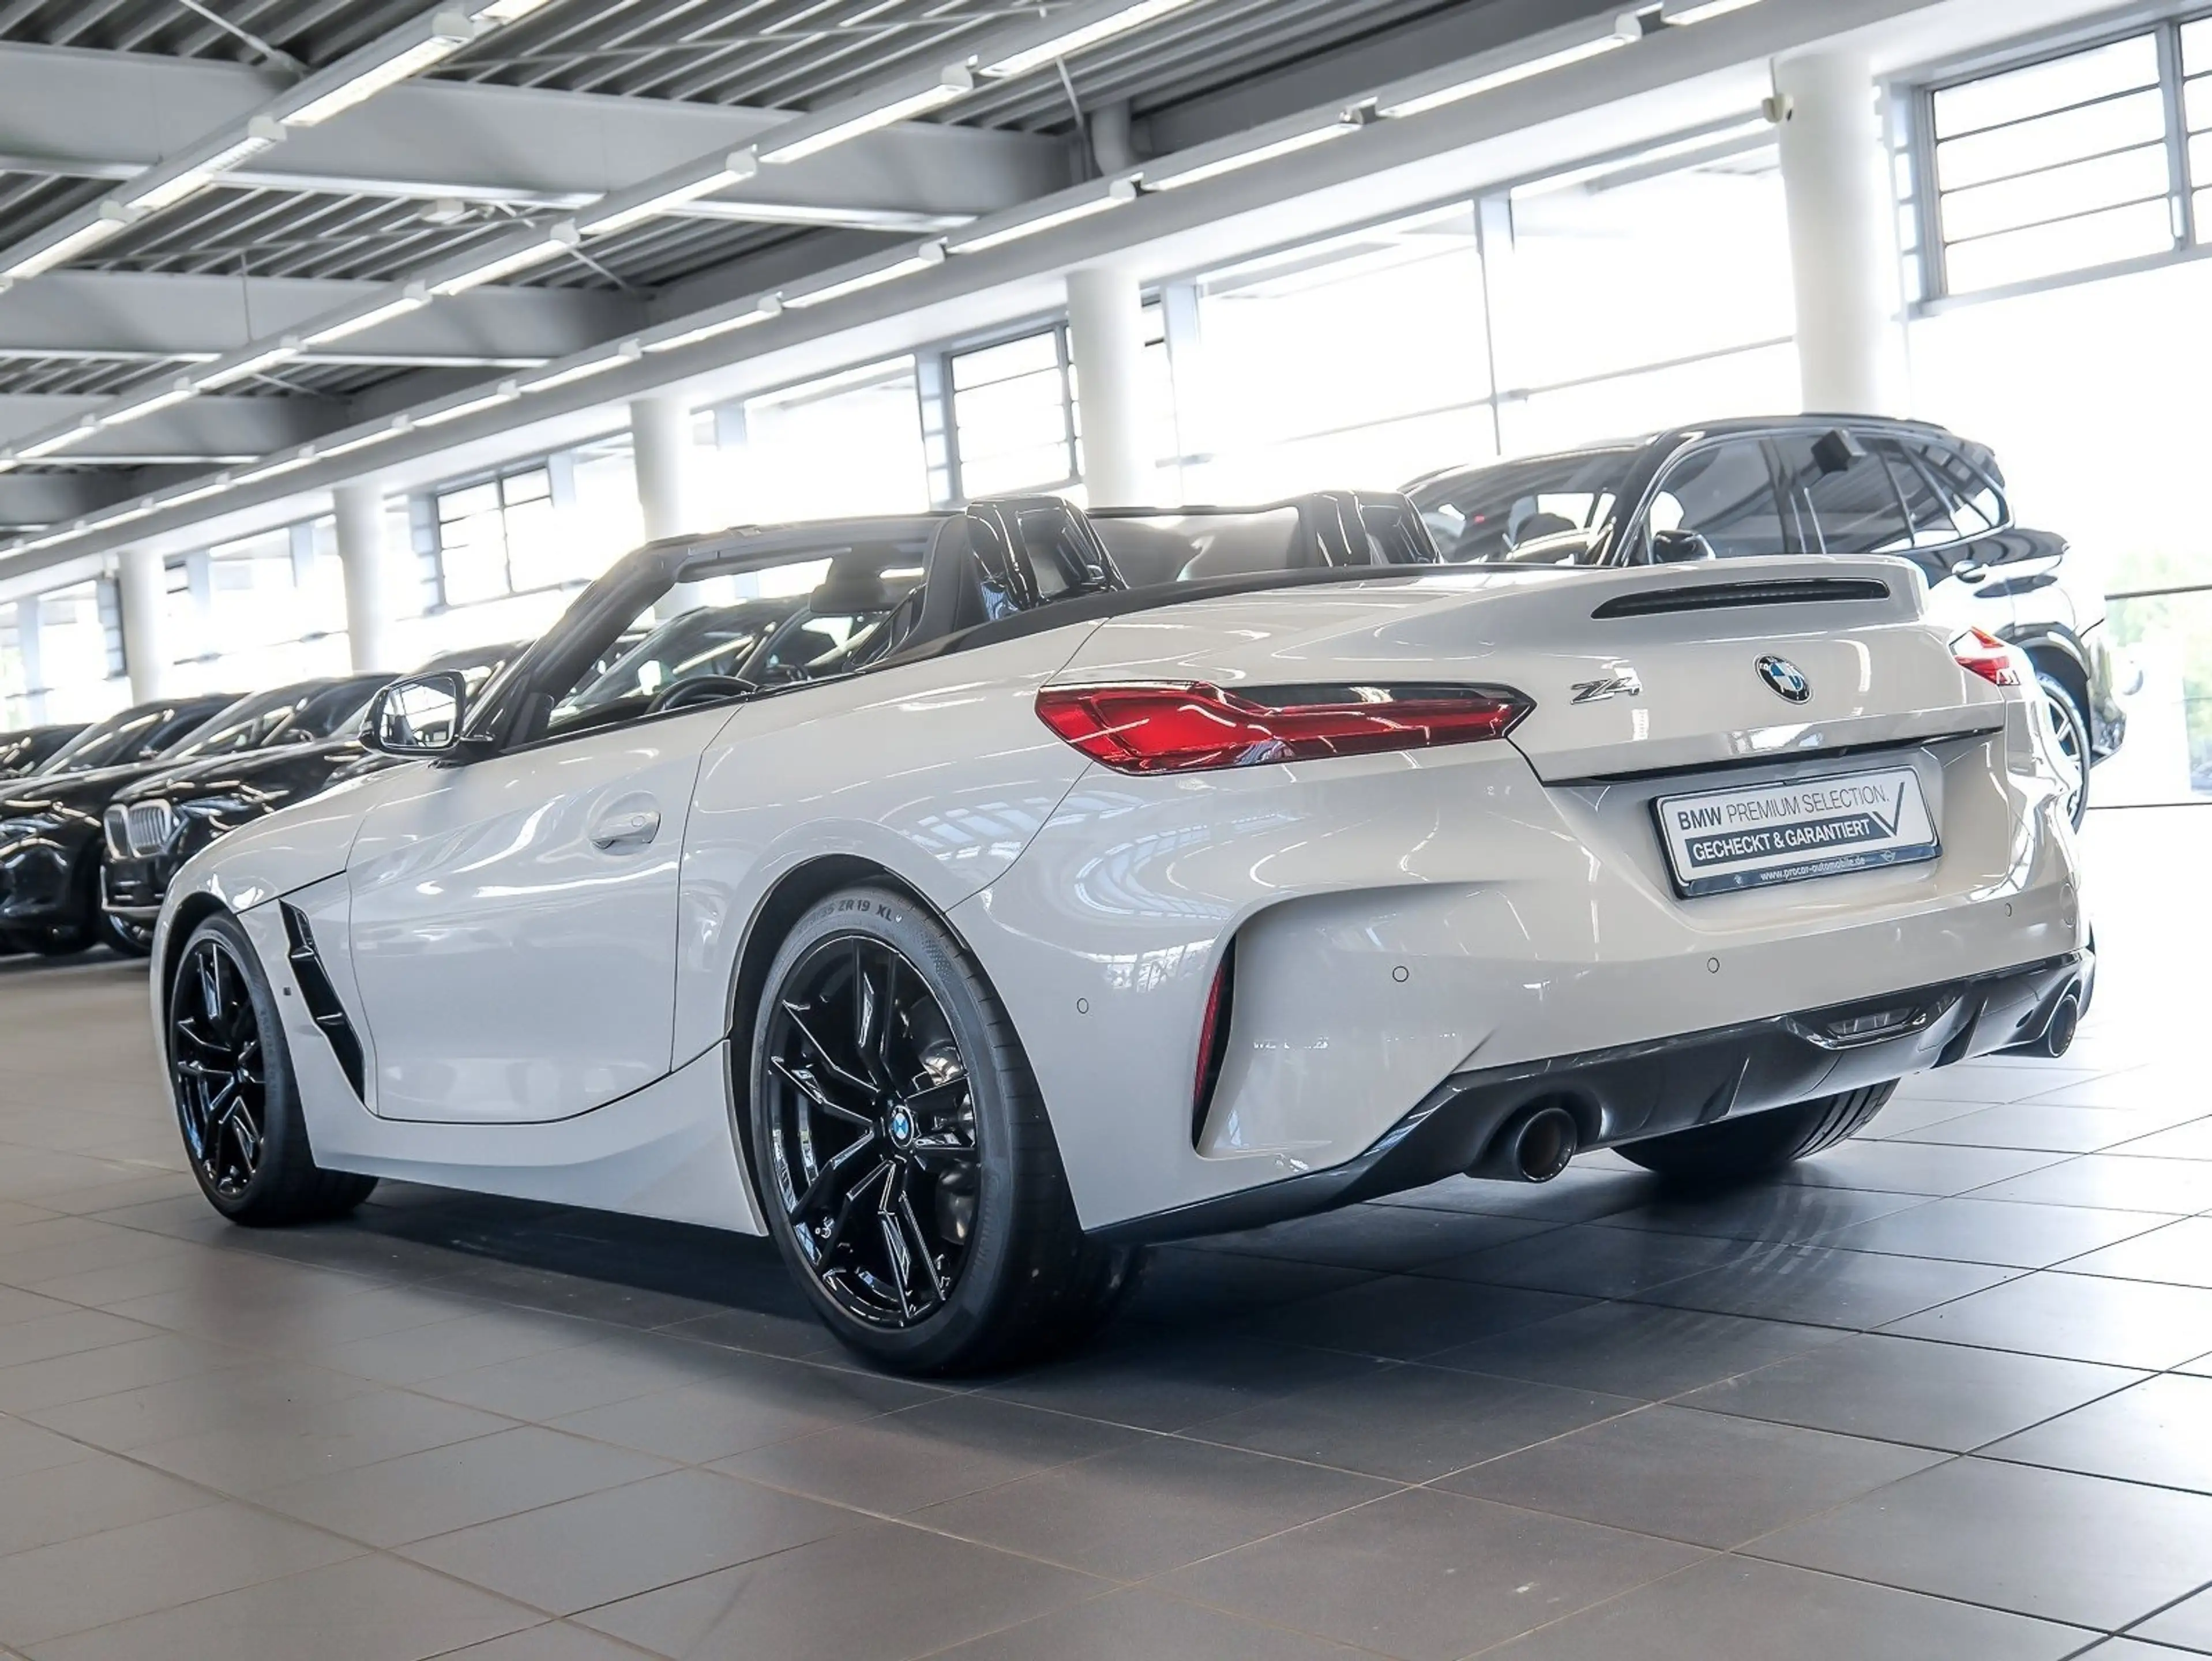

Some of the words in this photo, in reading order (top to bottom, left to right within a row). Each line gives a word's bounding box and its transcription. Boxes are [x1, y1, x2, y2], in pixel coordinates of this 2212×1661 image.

[1570, 677, 1640, 705] Z4
[1677, 806, 1722, 830] BMW
[1726, 796, 1801, 823] PREMIUM
[1802, 784, 1890, 813] SELECTION.
[1692, 833, 1771, 861] GECHECKT
[1773, 832, 1785, 849] &
[1785, 819, 1869, 847] GARANTIERT
[876, 904, 892, 922] XL
